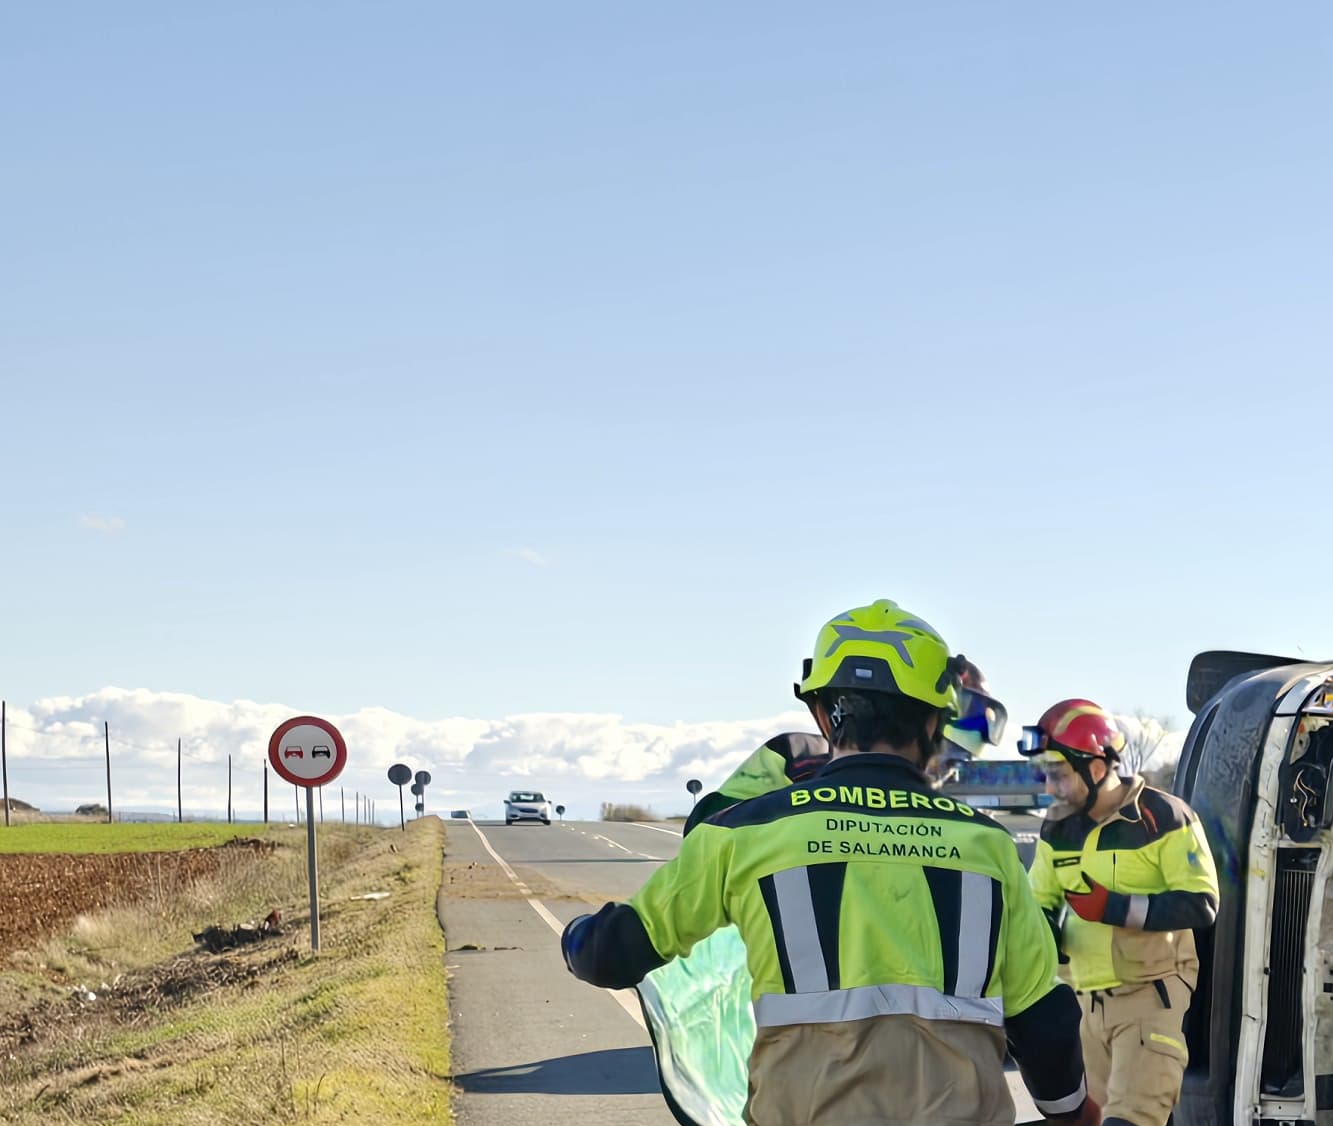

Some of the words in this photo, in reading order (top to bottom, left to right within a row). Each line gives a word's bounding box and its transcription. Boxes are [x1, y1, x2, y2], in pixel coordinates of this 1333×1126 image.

[790, 786, 975, 817] BOMBEROS
[826, 818, 942, 837] DIPUTACIÓN
[807, 841, 833, 854] DE
[839, 841, 961, 859] SALAMANCA
